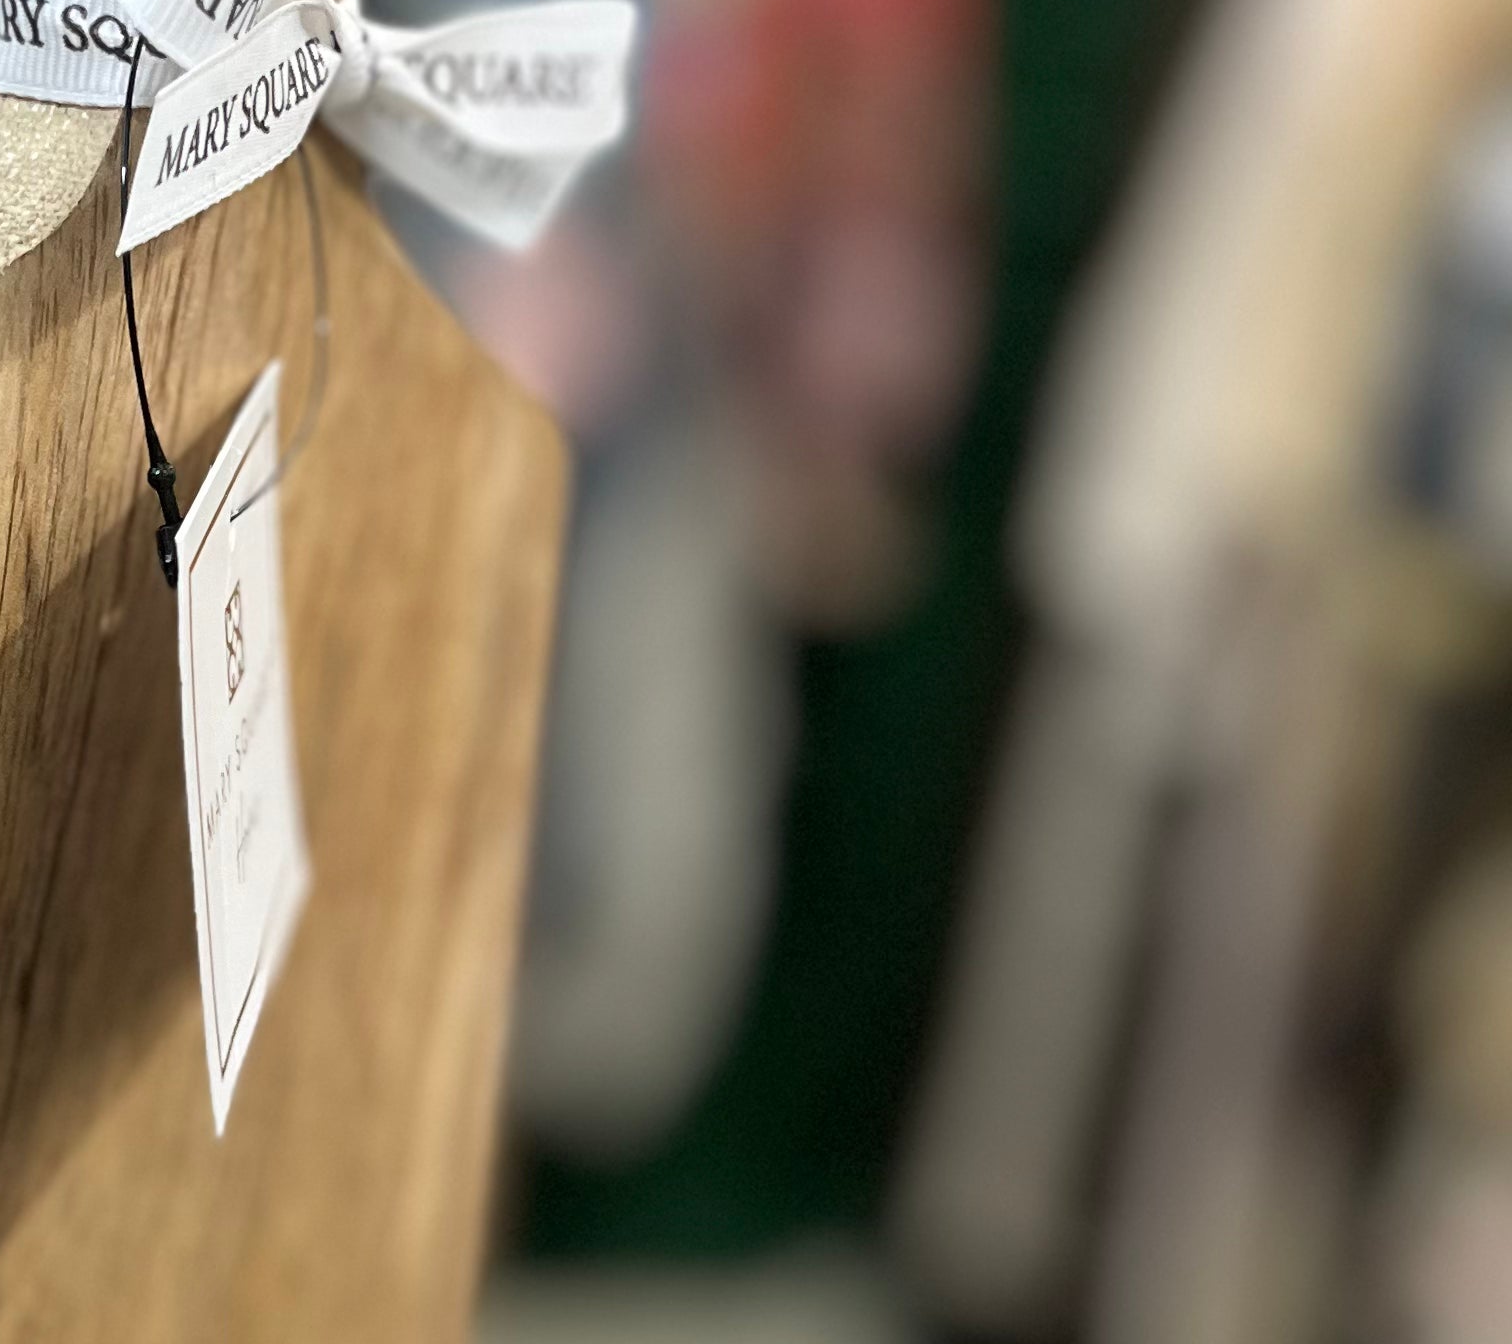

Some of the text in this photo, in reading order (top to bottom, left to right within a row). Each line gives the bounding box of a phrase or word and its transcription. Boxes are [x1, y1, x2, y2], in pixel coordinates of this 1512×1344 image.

[60, 3, 168, 65] SQ
[154, 36, 330, 188] MARY SQUARE
